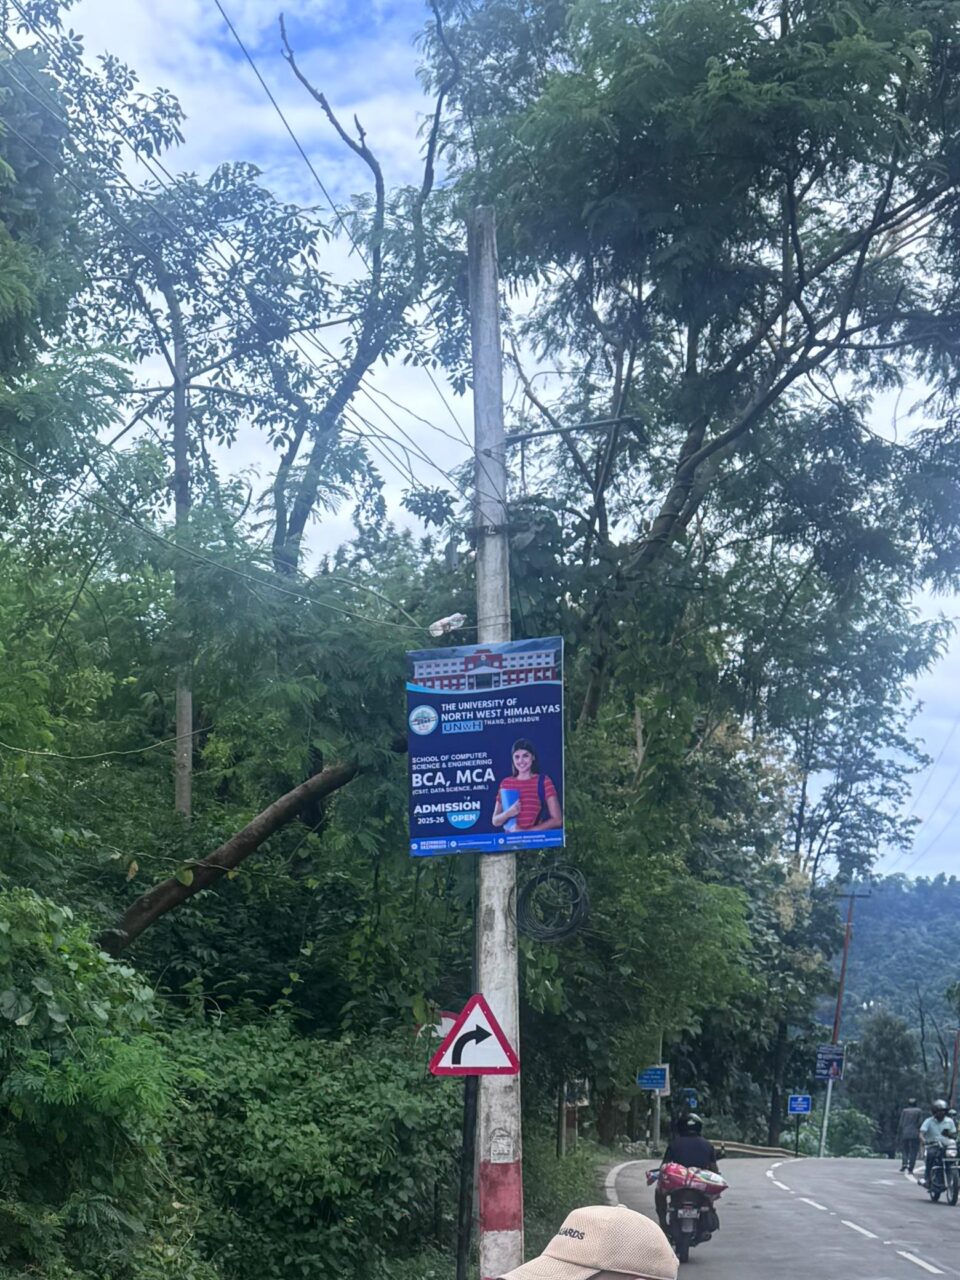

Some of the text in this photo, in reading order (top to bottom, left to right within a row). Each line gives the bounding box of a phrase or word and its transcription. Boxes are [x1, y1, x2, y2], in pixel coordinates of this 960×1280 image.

[442, 698, 518, 711] THE UNIVERSITY OF
[442, 704, 560, 721] NORTH WEST HIMALAYAS
[451, 752, 487, 760] COMPUTER
[448, 759, 492, 767] ENGINEERING
[412, 768, 495, 787] BCA, MCA
[414, 801, 480, 814] ADMISSION
